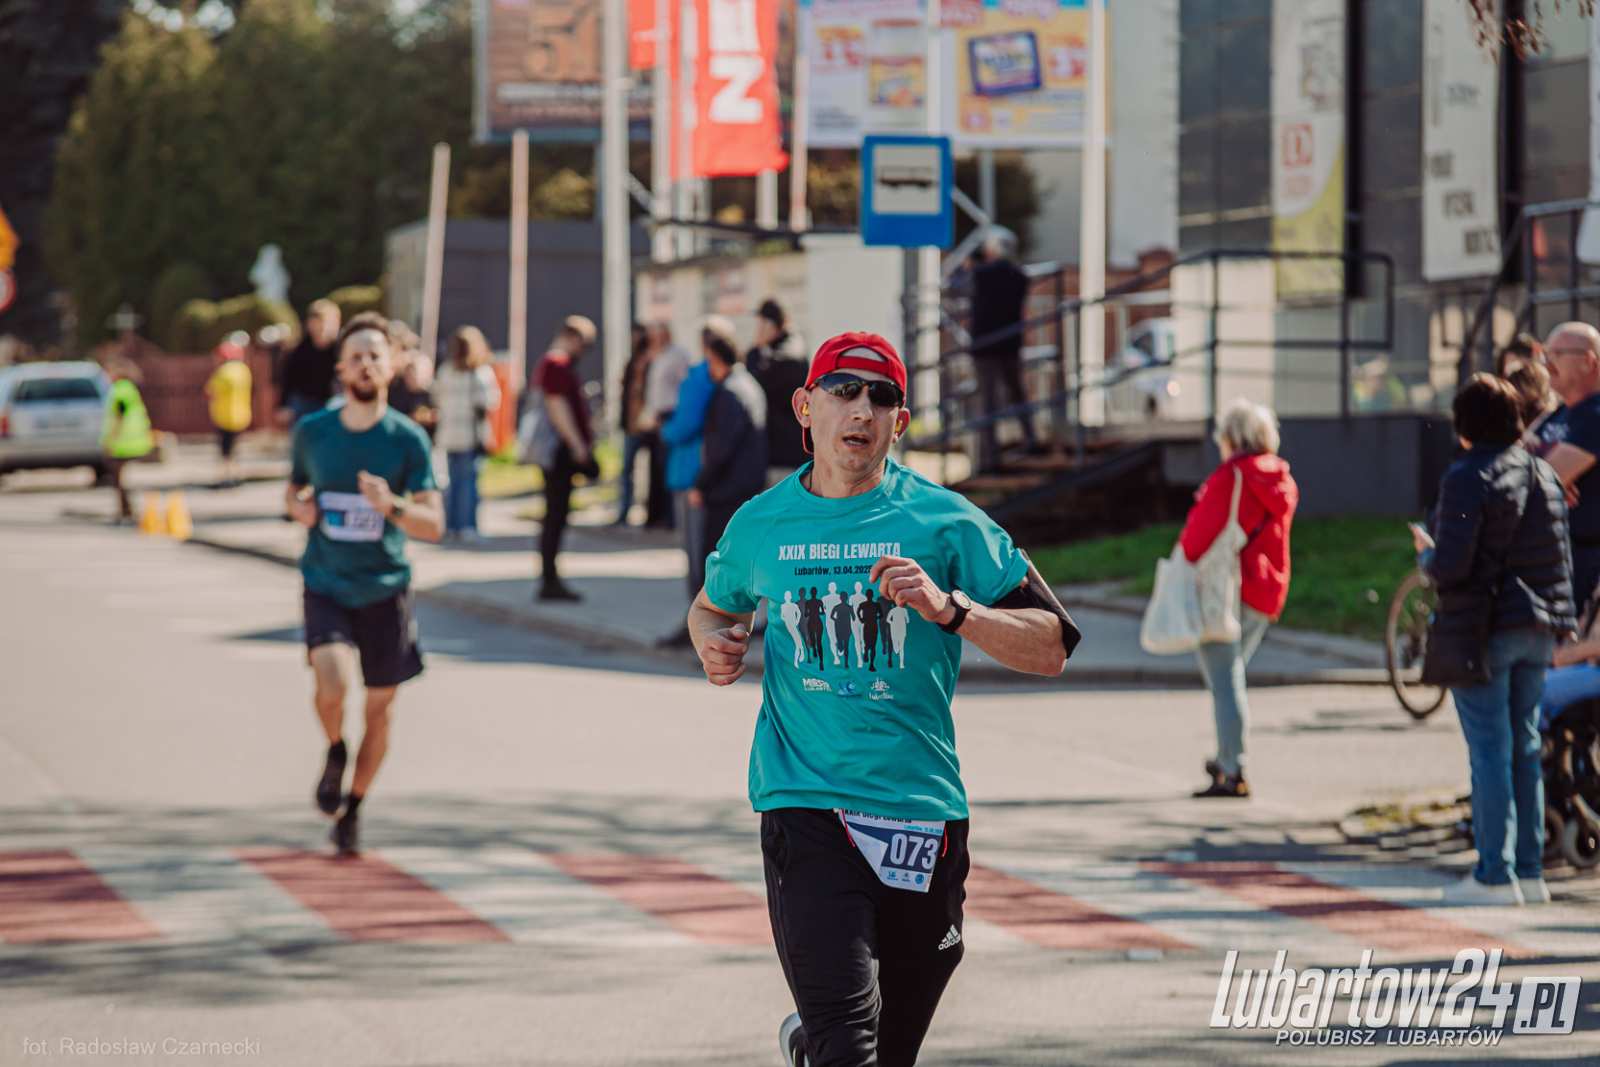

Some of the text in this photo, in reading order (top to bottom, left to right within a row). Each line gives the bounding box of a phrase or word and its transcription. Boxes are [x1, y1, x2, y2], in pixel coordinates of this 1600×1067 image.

[778, 542, 901, 561] XXIX BIEGI LEWARTA
[890, 833, 938, 870] 073
